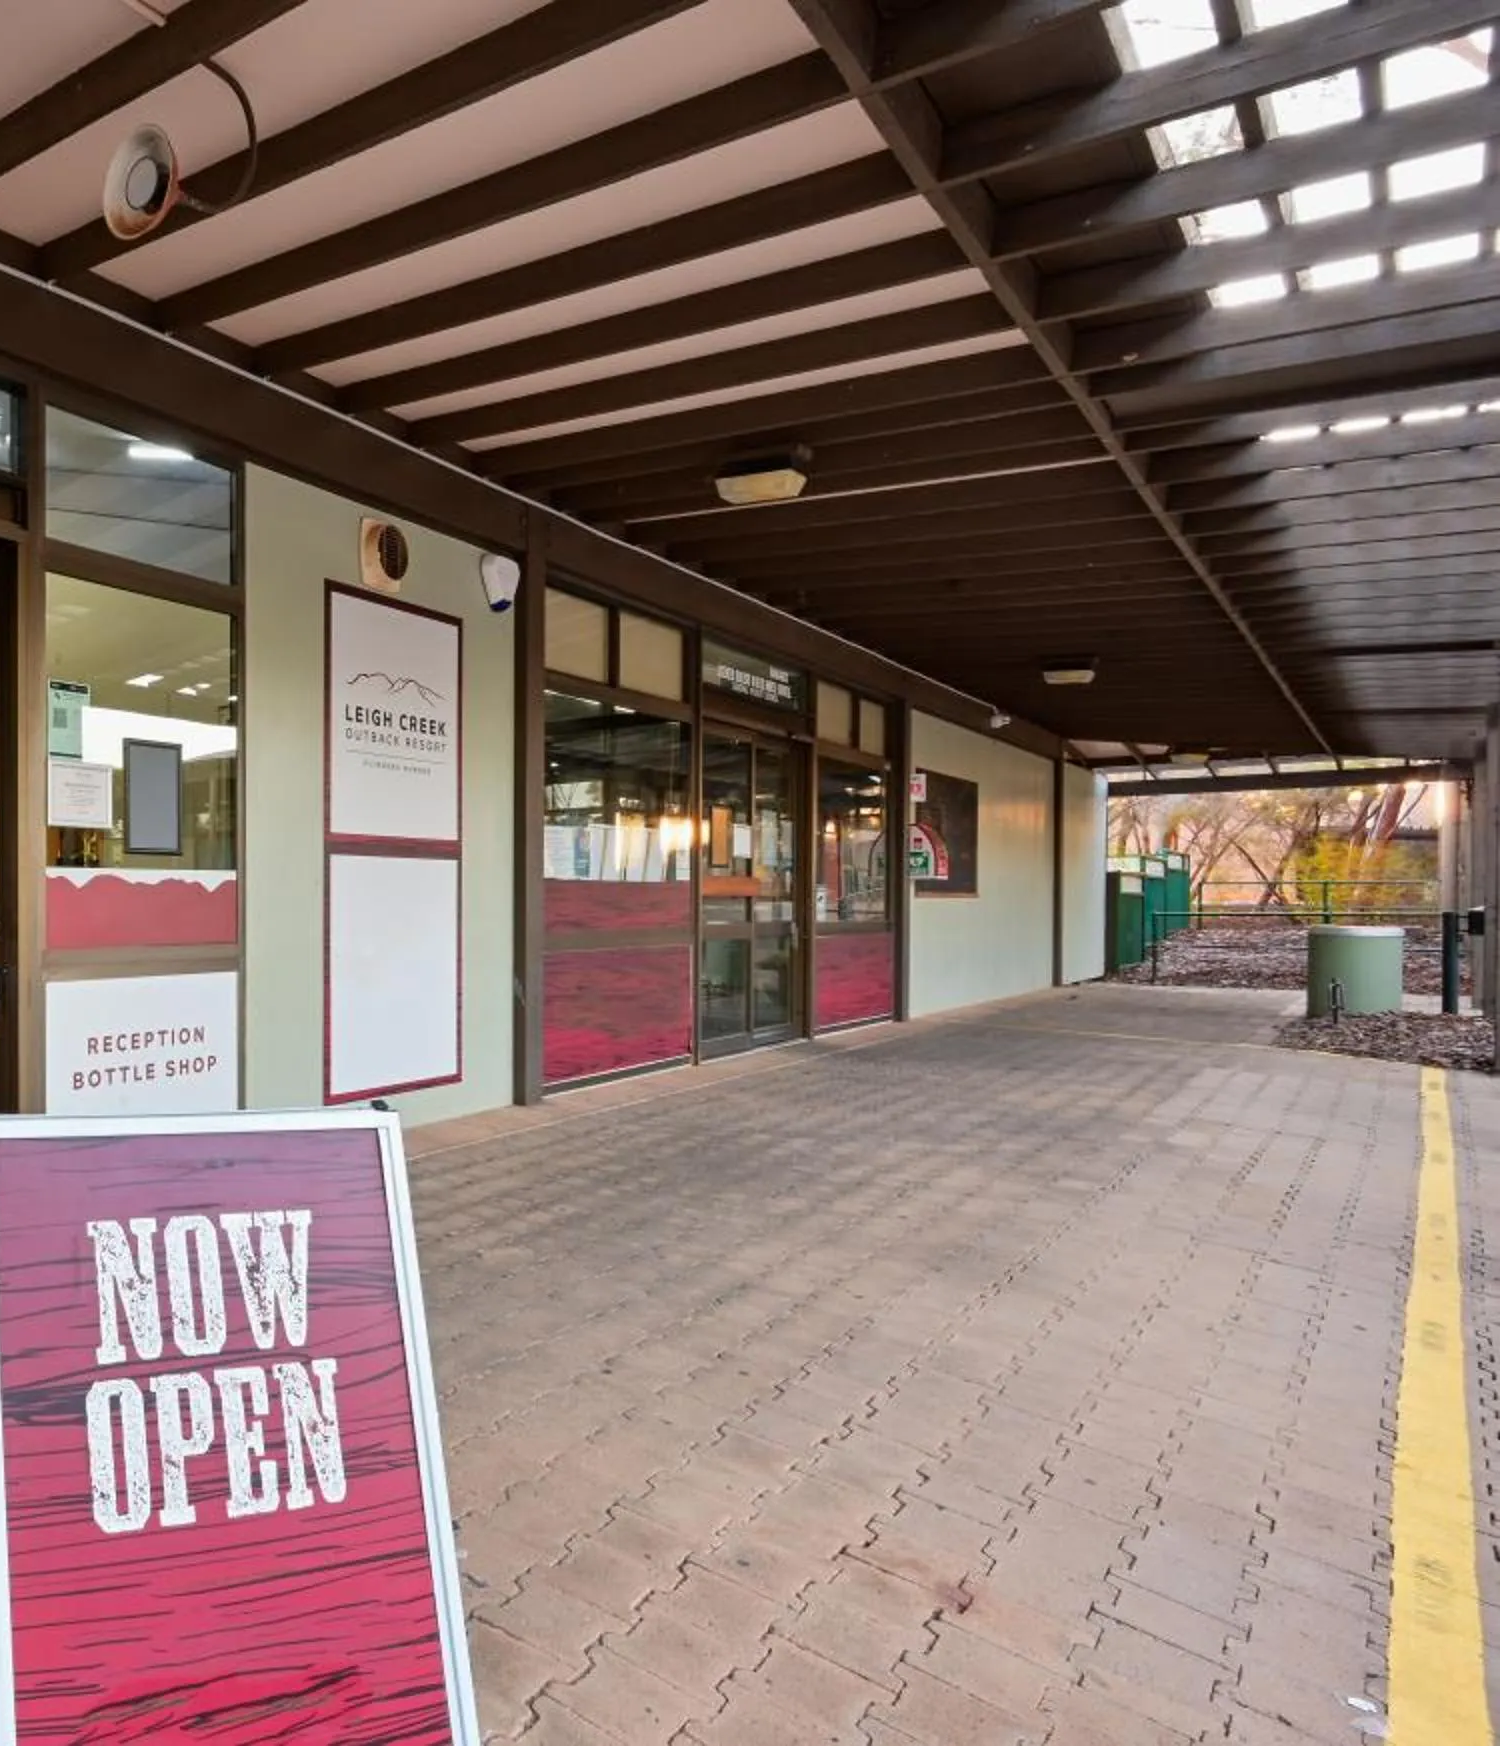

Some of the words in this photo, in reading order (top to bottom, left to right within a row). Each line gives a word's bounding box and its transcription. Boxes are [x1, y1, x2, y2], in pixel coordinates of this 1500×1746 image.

[344, 703, 394, 728] LEIGH
[399, 713, 448, 738] CREEK
[345, 727, 400, 747] OUTBACK
[405, 736, 448, 753] RESORT
[86, 1025, 206, 1056] RECEPTION
[72, 1062, 157, 1091] BOTTLE
[164, 1054, 218, 1078] SHOP
[86, 1208, 312, 1366] NOW
[85, 1357, 348, 1535] OPEN
